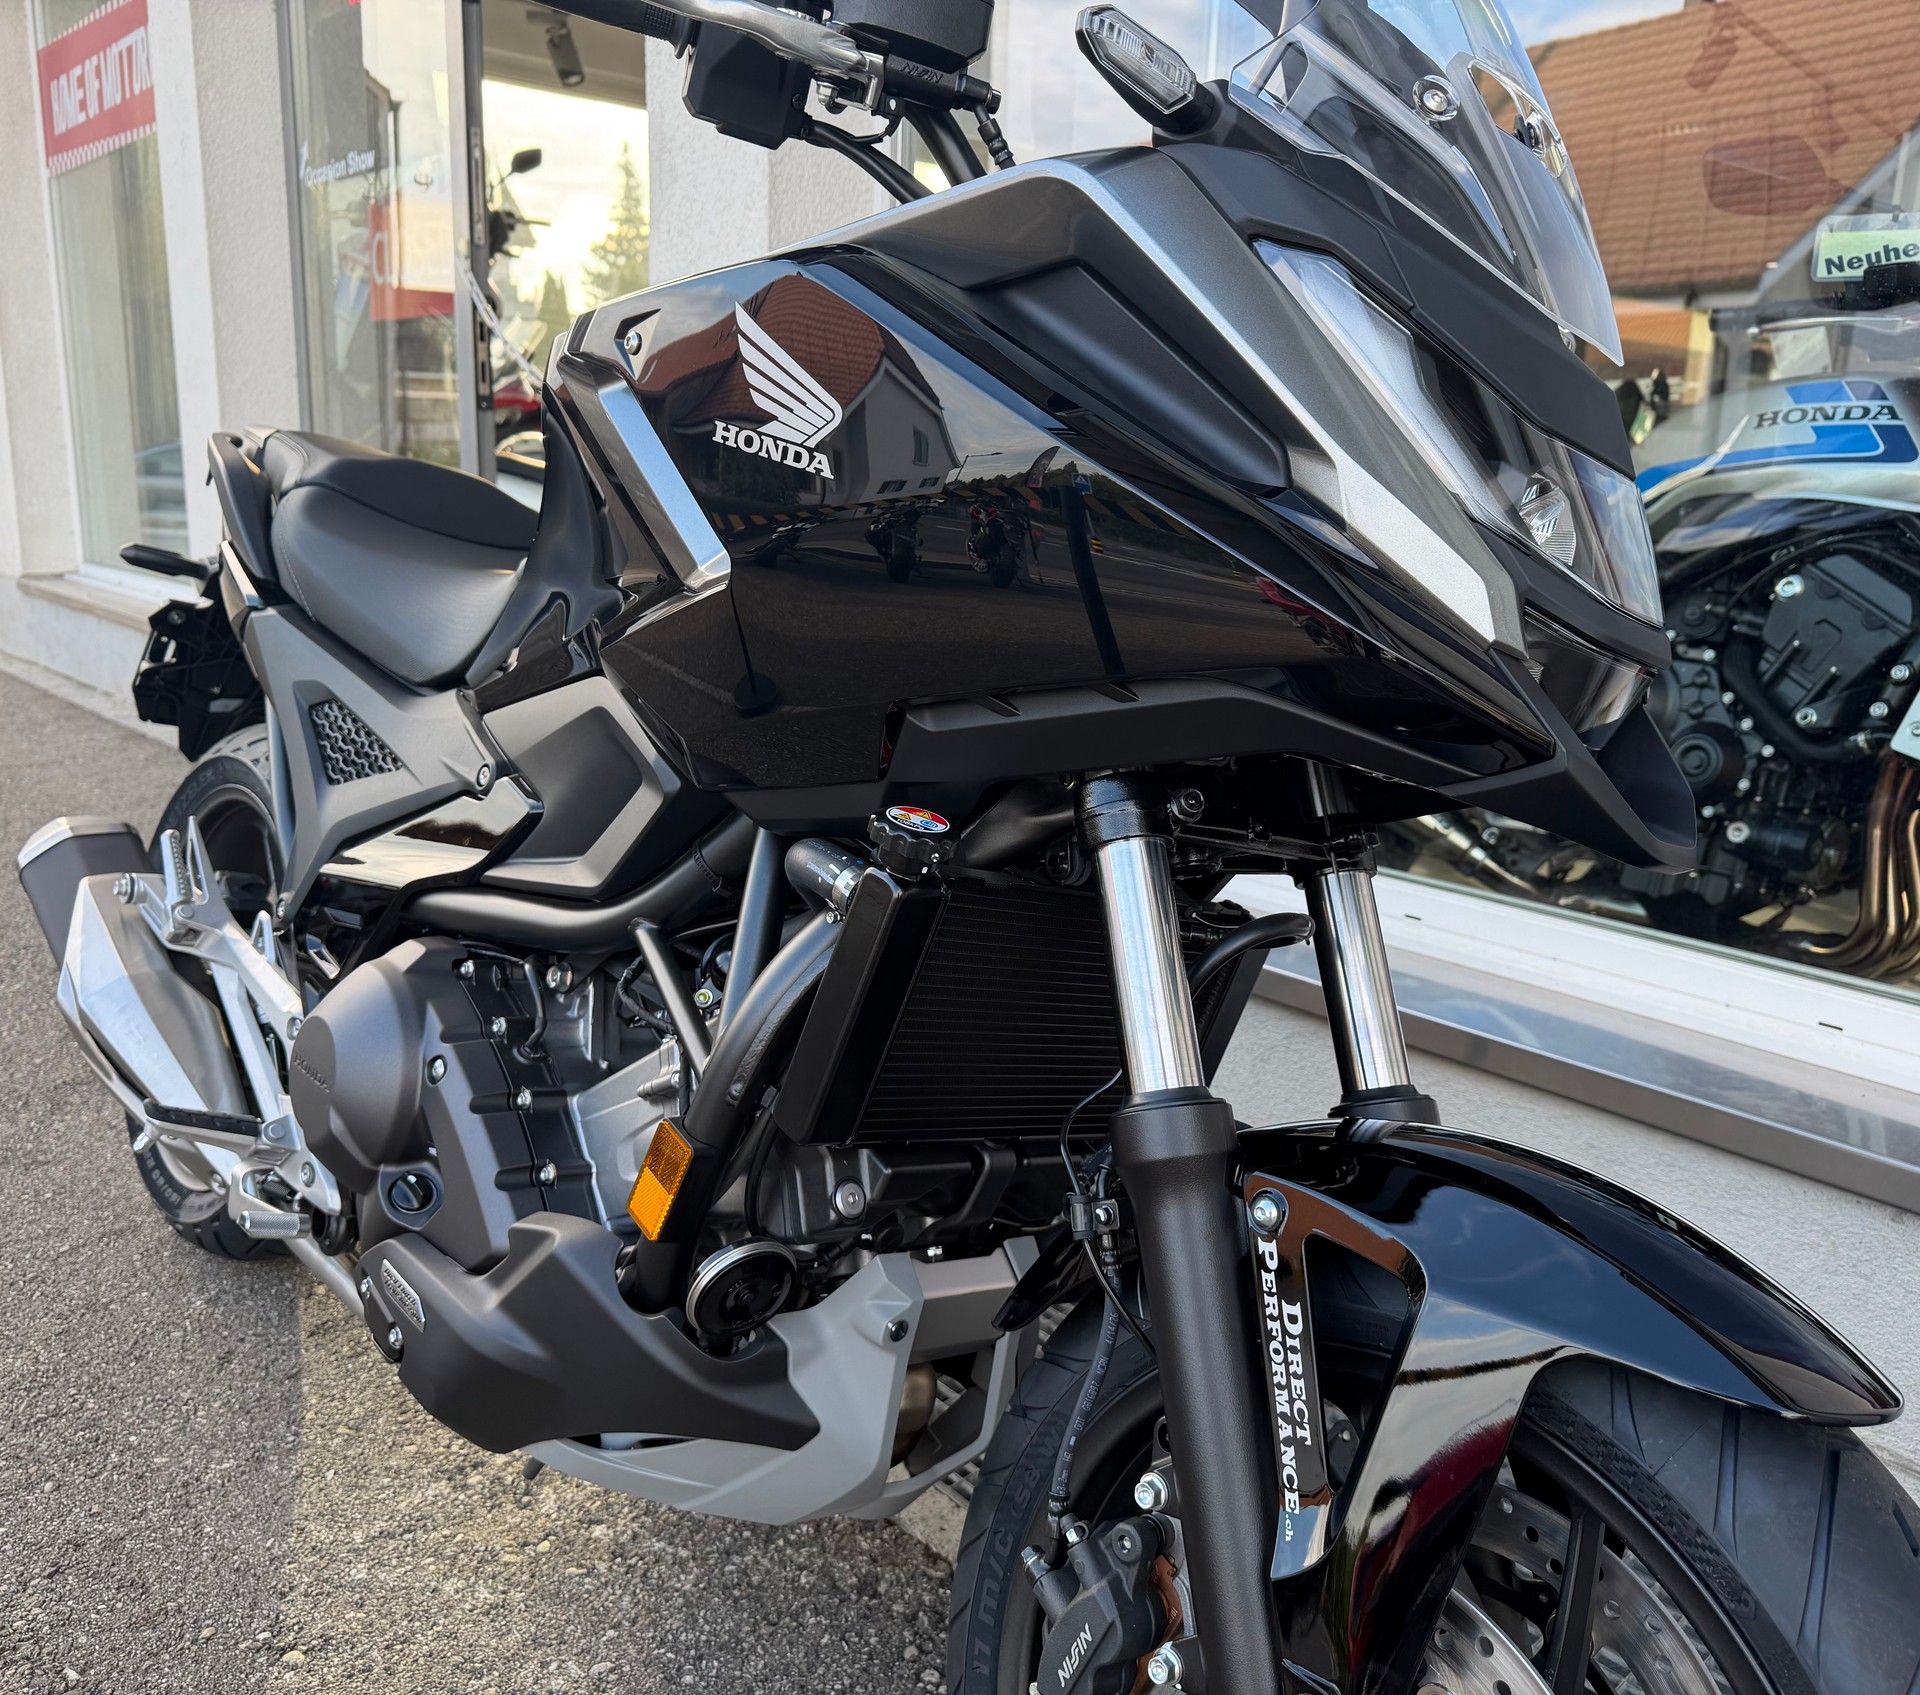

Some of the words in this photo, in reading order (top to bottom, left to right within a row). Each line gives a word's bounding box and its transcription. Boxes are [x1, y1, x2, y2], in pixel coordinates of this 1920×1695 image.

[305, 158, 346, 187] Occasion
[347, 150, 375, 176] Show
[1754, 404, 1904, 430] HONDA
[712, 420, 834, 480] HONDA
[1281, 1299, 1312, 1447] DIRECT
